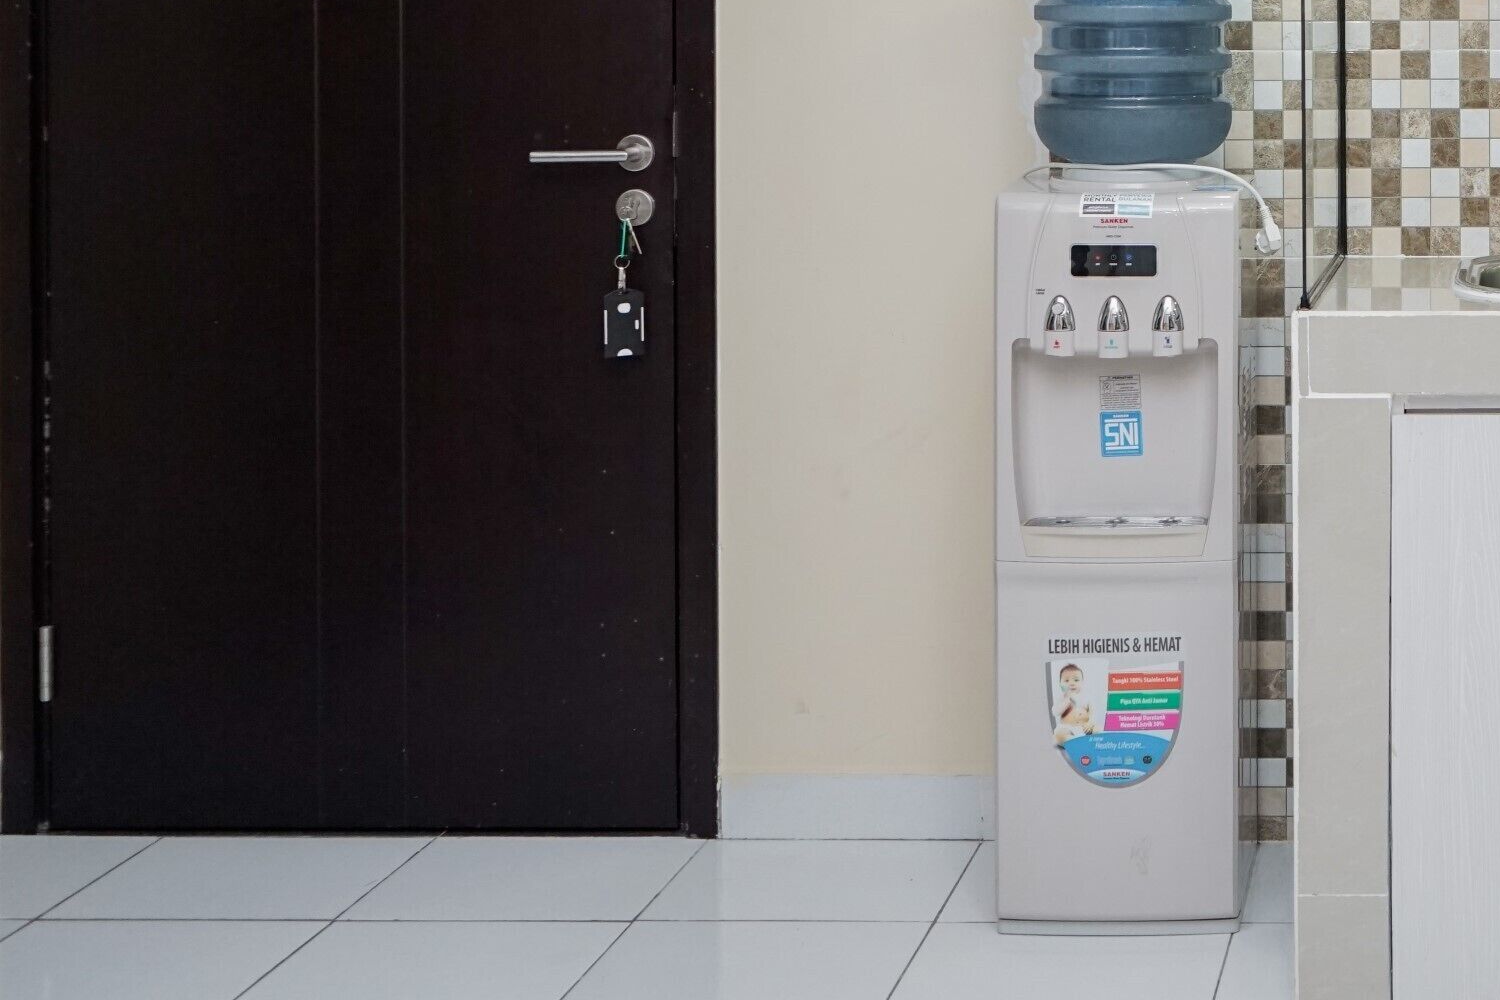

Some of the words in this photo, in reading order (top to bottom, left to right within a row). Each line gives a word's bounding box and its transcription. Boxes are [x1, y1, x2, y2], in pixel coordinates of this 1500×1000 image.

[1104, 422, 1139, 447] SNI
[1048, 639, 1080, 654] LEBIH
[1082, 638, 1130, 653] HIGIENIS
[1132, 637, 1142, 653] &
[1144, 636, 1182, 652] HEMAT
[1165, 675, 1179, 683] Steel
[1095, 741, 1117, 750] Healthy
